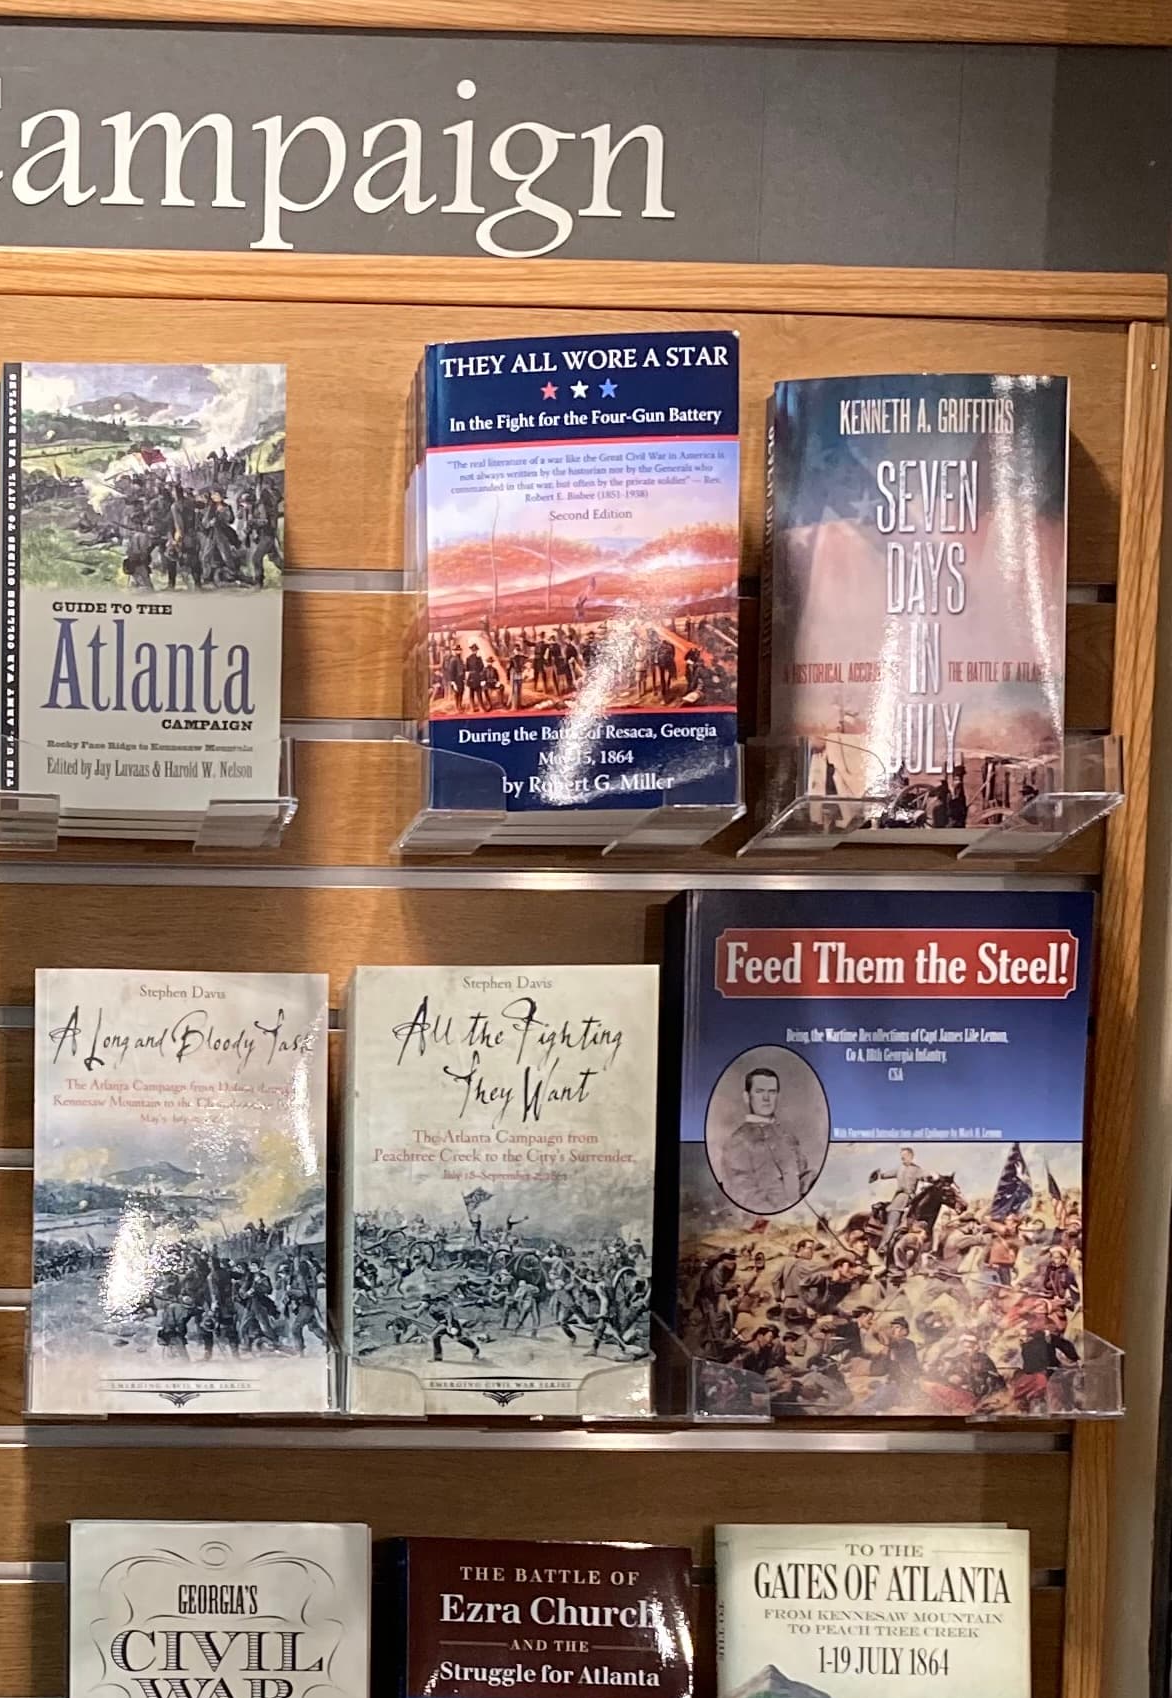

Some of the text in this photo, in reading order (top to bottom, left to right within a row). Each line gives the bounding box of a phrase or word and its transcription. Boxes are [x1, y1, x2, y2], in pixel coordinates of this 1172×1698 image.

[440, 346, 728, 378] THEY ALL WORE A STAR
[450, 407, 722, 433] In the Fight for the Four-Gun Battery
[840, 399, 1013, 434] KENNETH A. GRIFFITHS
[877, 460, 978, 535] SEVEN
[886, 542, 965, 614] DAYS
[52, 601, 172, 615] GUIDE TO THE
[40, 617, 255, 714] Atlanta
[162, 719, 252, 731] CAMPAIGN
[47, 757, 252, 780] Edited by Jay Luvaas & Harold W. Nelson
[726, 941, 1069, 985] Feed Them the Steel!
[392, 996, 624, 1071] All the Fighting
[443, 1050, 598, 1130] They Want
[460, 1566, 640, 1586] THE BATTLE OF
[754, 1561, 1012, 1604] GATES OF ATLANTA
[178, 1584, 258, 1615] GEORGIA'S
[439, 1594, 659, 1628] Ezra Church
[110, 1630, 324, 1672] CIVIL
[440, 1661, 660, 1687] Struggle for Atlanta
